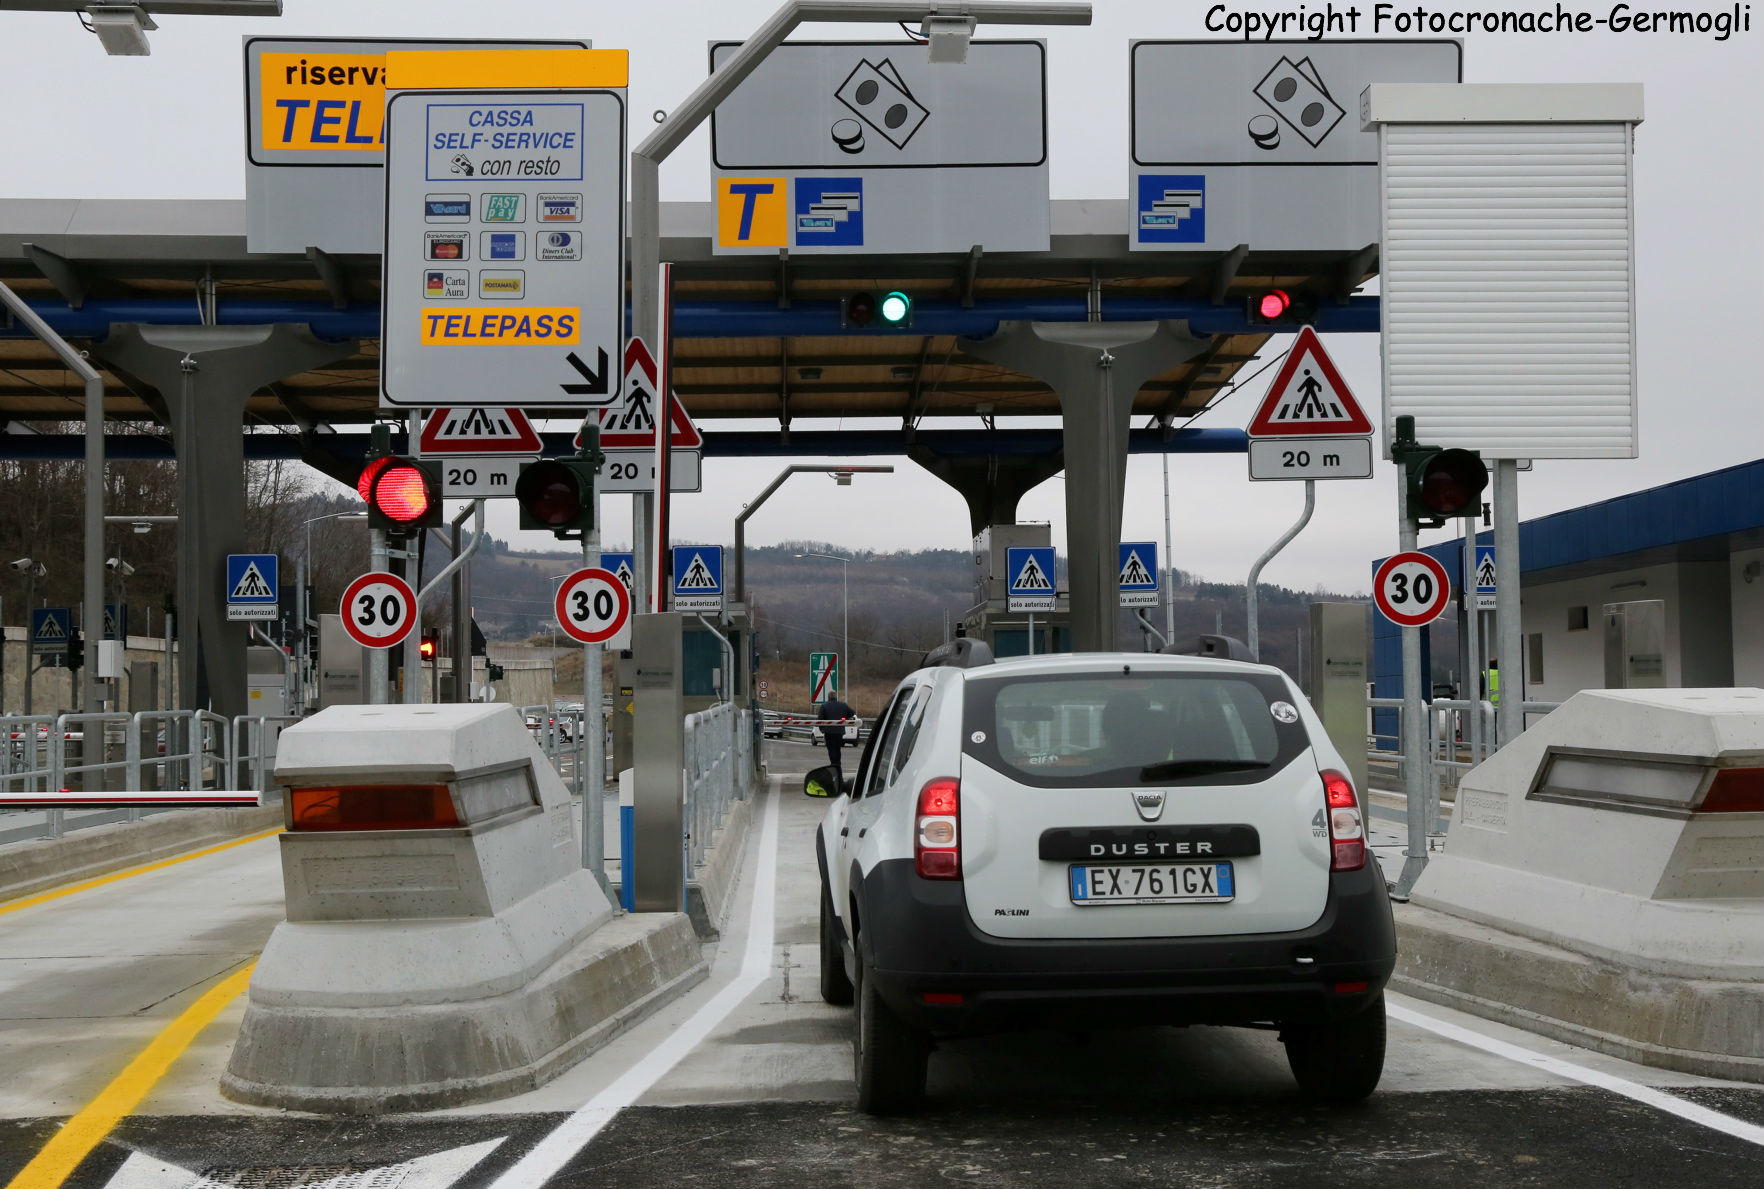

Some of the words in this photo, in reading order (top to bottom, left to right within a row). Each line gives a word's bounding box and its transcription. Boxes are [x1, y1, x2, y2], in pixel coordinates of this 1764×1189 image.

[286, 59, 385, 85] riserv
[276, 99, 384, 144] TEL
[468, 110, 534, 127] CASSA
[433, 132, 576, 149] SELF-SERVICE
[480, 159, 512, 176] con
[517, 155, 561, 176] resto
[490, 196, 518, 209] FAST
[549, 207, 571, 215] VISA
[487, 208, 515, 220] pay
[729, 184, 774, 240] T
[445, 276, 466, 286] Carta
[445, 287, 464, 297] Aura
[427, 314, 575, 338] TELEPASS
[1282, 451, 1310, 467] 20
[1323, 453, 1340, 466] m
[448, 469, 477, 486] 20
[490, 471, 508, 486] m
[609, 463, 639, 480] 20
[1391, 572, 1433, 605] 30
[357, 594, 401, 627] 30
[571, 589, 614, 622] 30
[690, 599, 720, 607] autorizzati
[1024, 600, 1055, 608] autorizzati
[229, 608, 243, 616] solo
[244, 608, 276, 616] autorizzati
[1312, 808, 1327, 829] 4
[1090, 842, 1214, 856] DUSTER
[1090, 867, 1123, 896] EX
[1131, 866, 1215, 896] 761GX
